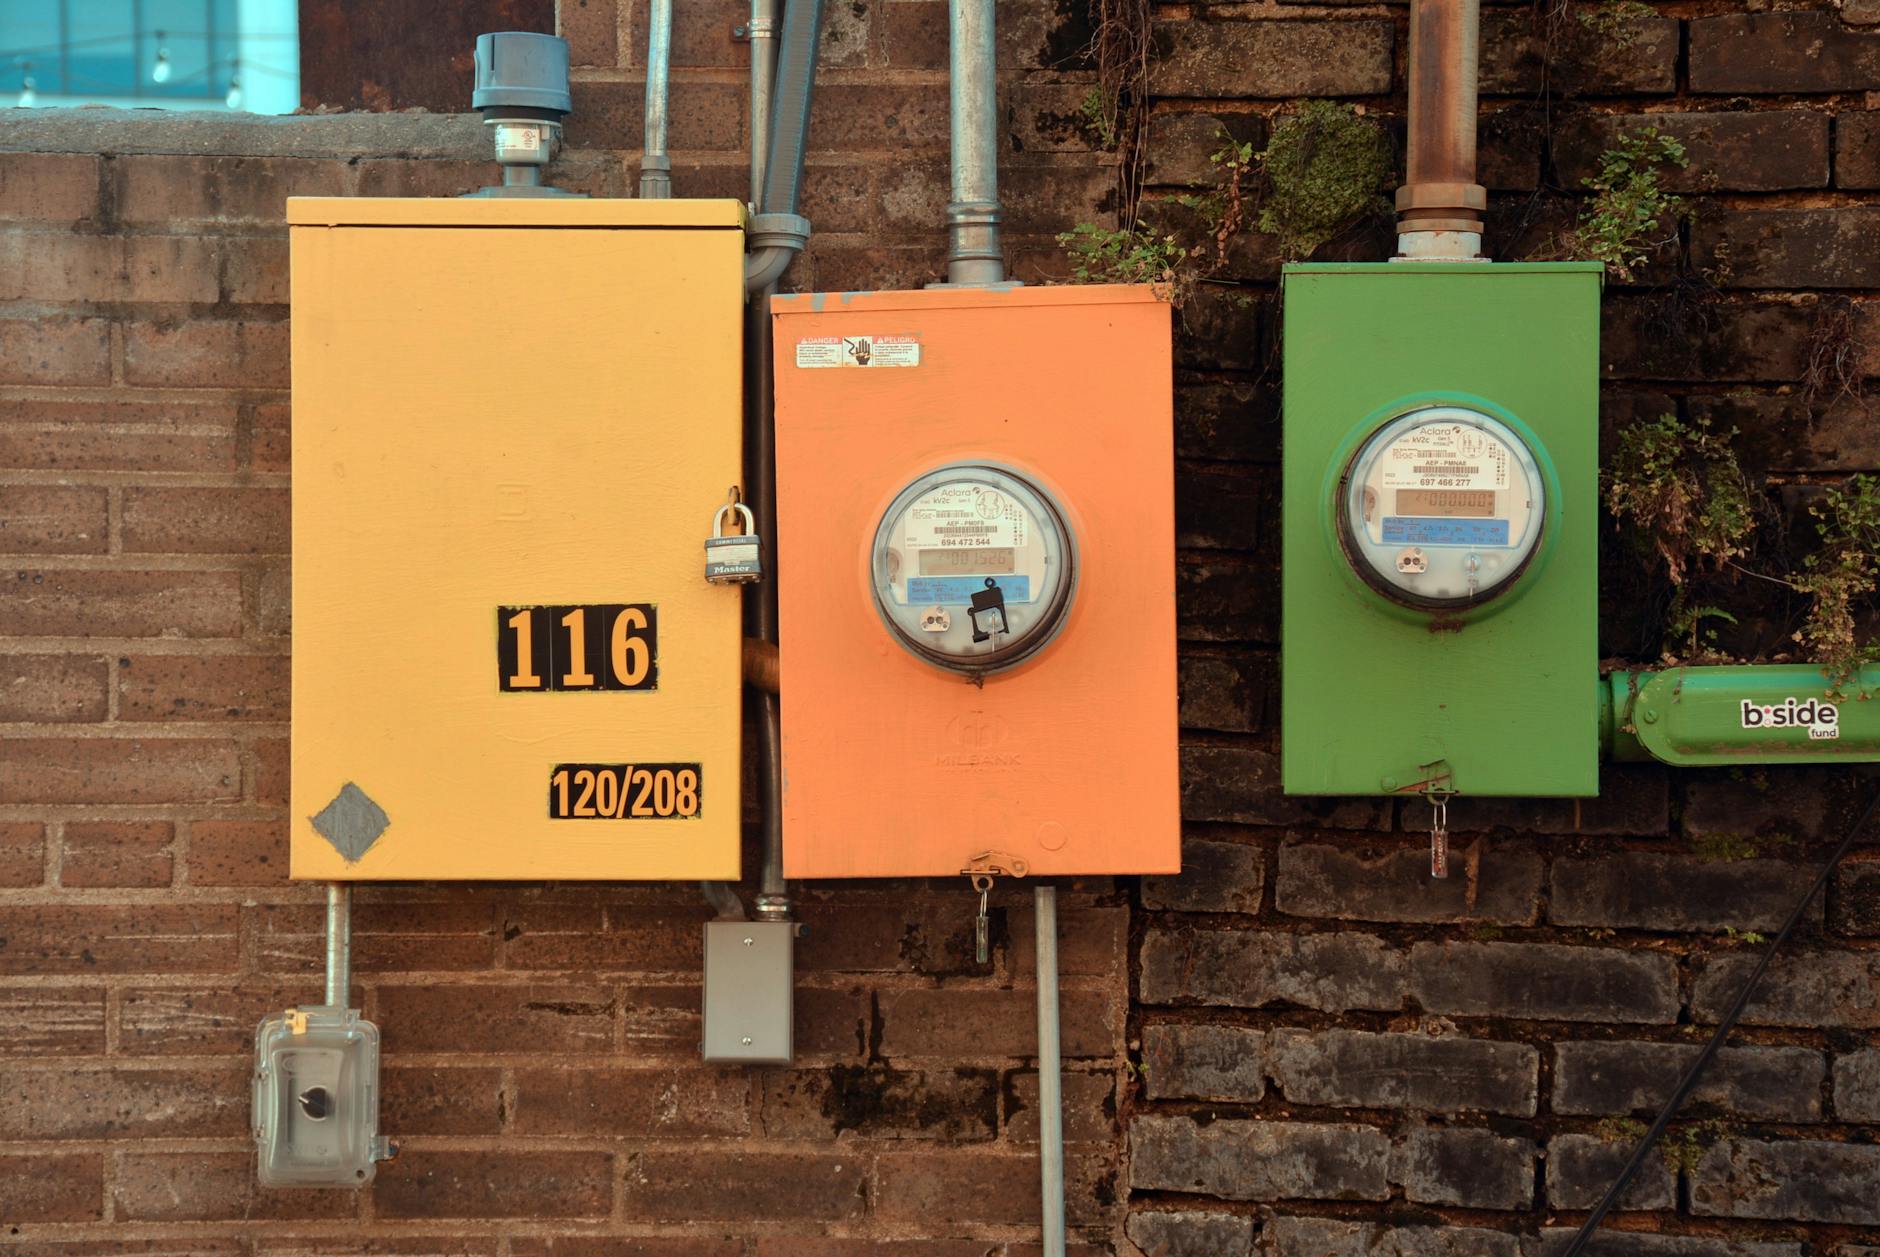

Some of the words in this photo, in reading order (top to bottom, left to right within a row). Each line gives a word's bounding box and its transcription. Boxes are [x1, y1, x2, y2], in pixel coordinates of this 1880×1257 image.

[1420, 427, 1451, 436] Aclara
[1412, 436, 1430, 444] kV2c
[1420, 478, 1434, 486] 697
[941, 488, 971, 497] Aclara
[933, 496, 950, 504] kV2c
[958, 538, 973, 546] 472
[714, 566, 751, 574] Master
[508, 607, 650, 688] 116
[1811, 728, 1837, 737] fund
[552, 765, 698, 819] 120/208
